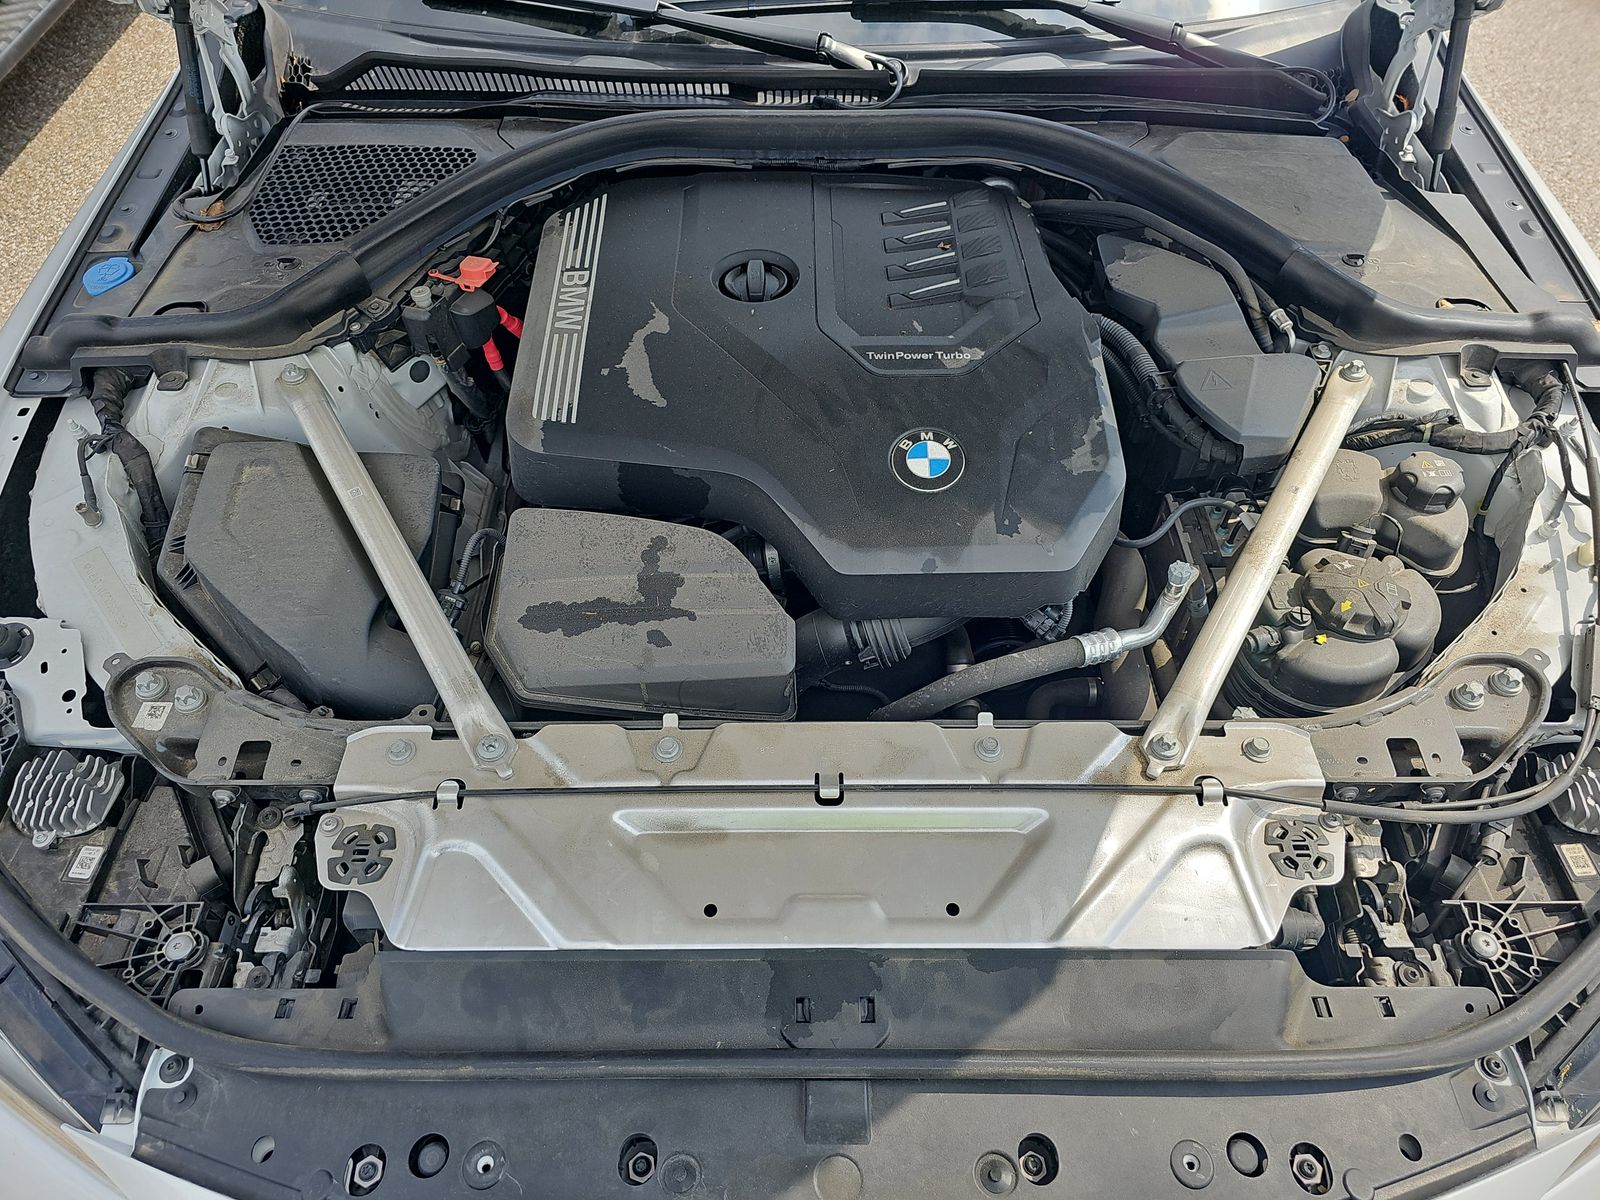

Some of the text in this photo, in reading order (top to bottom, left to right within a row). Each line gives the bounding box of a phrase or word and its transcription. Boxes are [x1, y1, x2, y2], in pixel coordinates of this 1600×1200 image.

[554, 270, 590, 330] BMW
[865, 351, 971, 360] TwinPower Turbo
[898, 431, 958, 451] BMW
